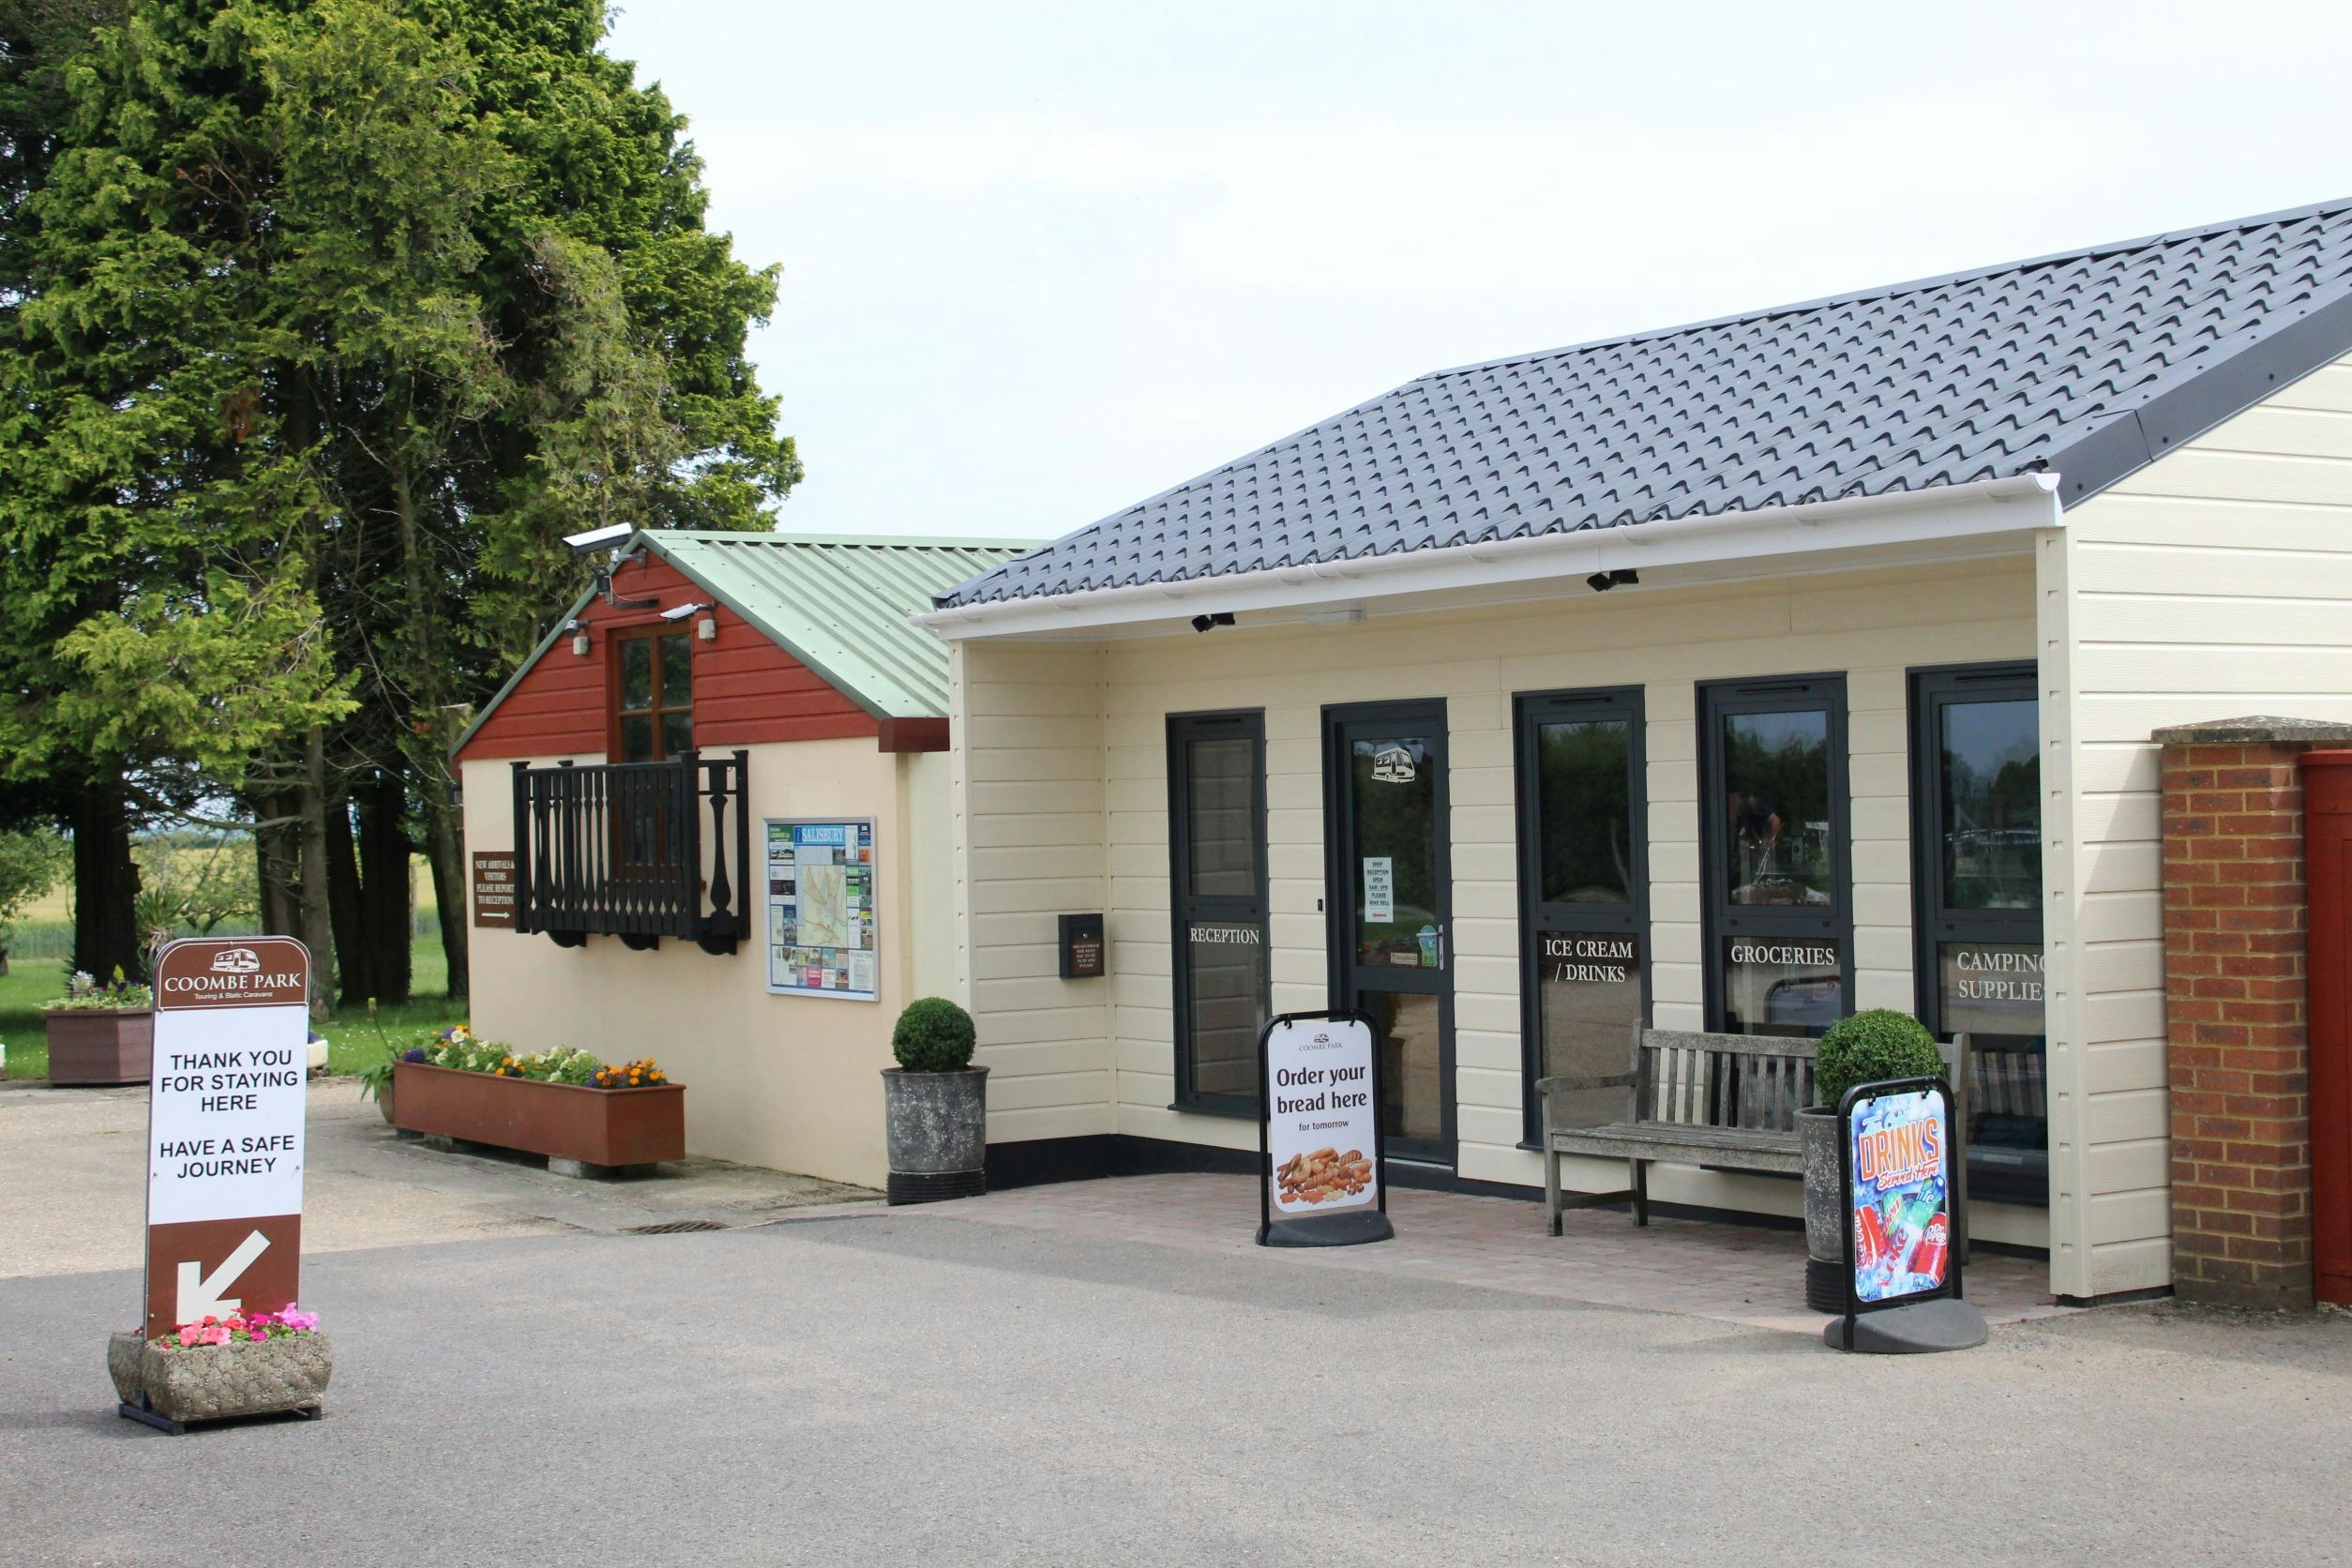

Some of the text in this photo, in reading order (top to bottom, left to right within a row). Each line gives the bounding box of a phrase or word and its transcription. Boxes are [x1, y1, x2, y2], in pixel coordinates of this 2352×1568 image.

[802, 827, 844, 842] SALISBURY
[1190, 927, 1259, 944] RECEPTION
[1545, 940, 1634, 958] ICE CREAM
[1730, 945, 1835, 966] GROCERIES
[164, 973, 302, 992] COOMBE PARK
[1565, 964, 1626, 983] DRINKS
[1958, 979, 2045, 1001] SUPPLIE
[1298, 1043, 1326, 1051] COOMBE
[171, 1049, 292, 1070] THANK YOU
[161, 1071, 298, 1093] FOR STAYING
[1276, 1065, 1365, 1087] Order your
[202, 1094, 258, 1112] HERE
[1276, 1091, 1367, 1114] bread here
[1299, 1120, 1349, 1131] for tomorrow
[160, 1135, 294, 1158] HAVE A SAFE
[1859, 1117, 1939, 1182] DRINKS
[177, 1157, 277, 1179] JOURNEY
[1877, 1160, 1938, 1191] Served Here
